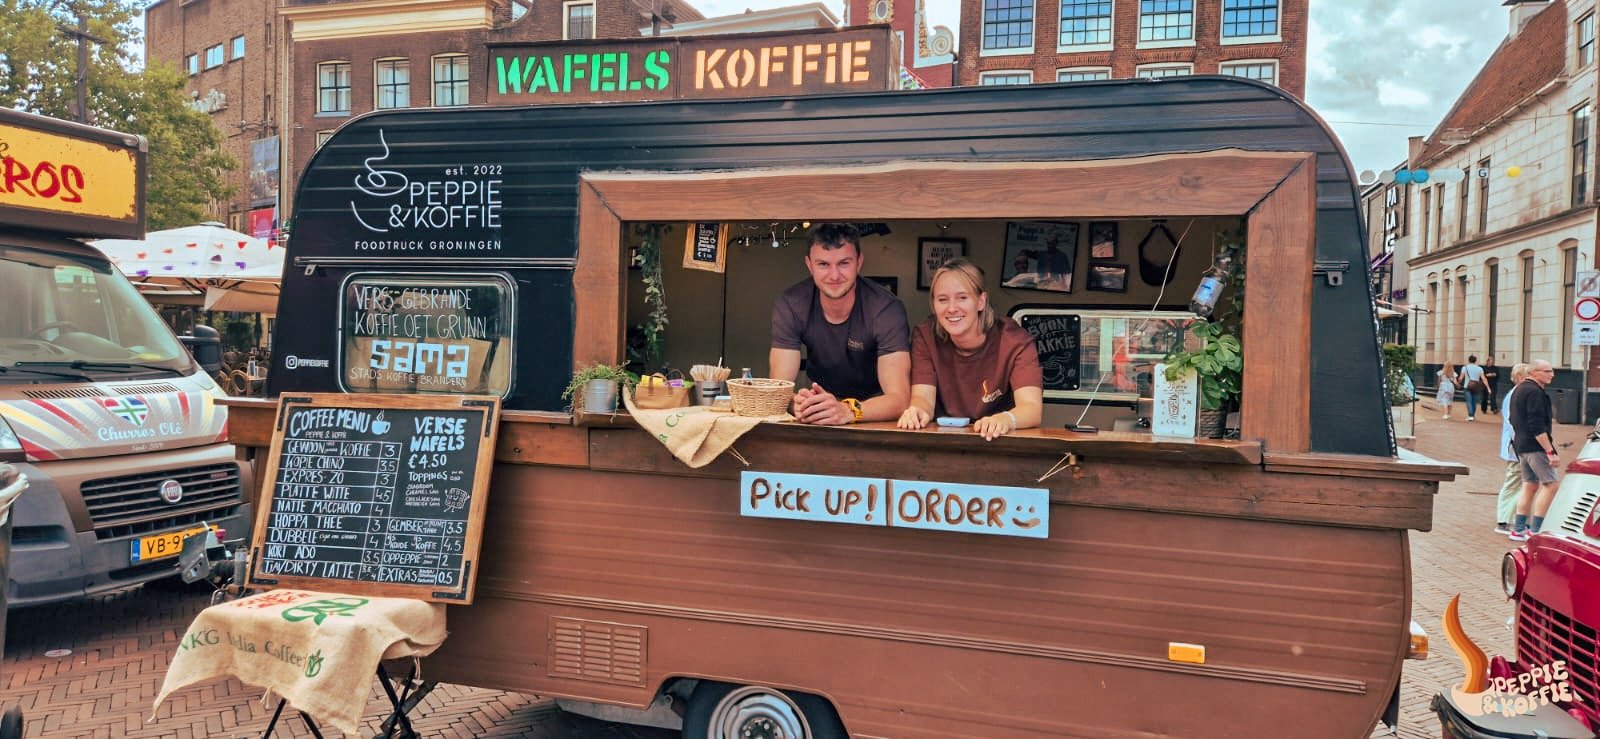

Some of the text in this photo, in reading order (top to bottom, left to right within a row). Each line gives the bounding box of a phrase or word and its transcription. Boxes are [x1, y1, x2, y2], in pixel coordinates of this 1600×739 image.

[496, 51, 670, 95] WAFELS
[0, 154, 84, 203] ROS
[473, 165, 503, 176] 2022
[410, 180, 503, 206] PEPPIE
[354, 241, 502, 250] FOODTRUCK GRONINGEN
[401, 288, 473, 311] GEBRANDE
[354, 311, 487, 339] KOFFIE OET GRUNN
[1037, 333, 1077, 355] AKKIE
[97, 421, 184, 441] Churros Olé
[290, 409, 370, 437] COFFEE MENU
[414, 416, 467, 435] VERSE
[339, 443, 373, 457] KOFFIE
[384, 444, 396, 458] 3
[409, 435, 465, 453] WAFELS
[380, 473, 391, 486] 3
[280, 485, 320, 499] PLATTE
[323, 487, 351, 500] WITTE
[277, 499, 306, 513] NATTE
[374, 504, 384, 516] 4
[274, 513, 381, 532] HOPPA THEE 3
[390, 519, 423, 533] GEMBER
[146, 533, 190, 555] VB-9
[369, 535, 379, 548] 4
[294, 546, 317, 559] ADO
[441, 554, 449, 567] 2
[321, 561, 355, 578] LATTE
